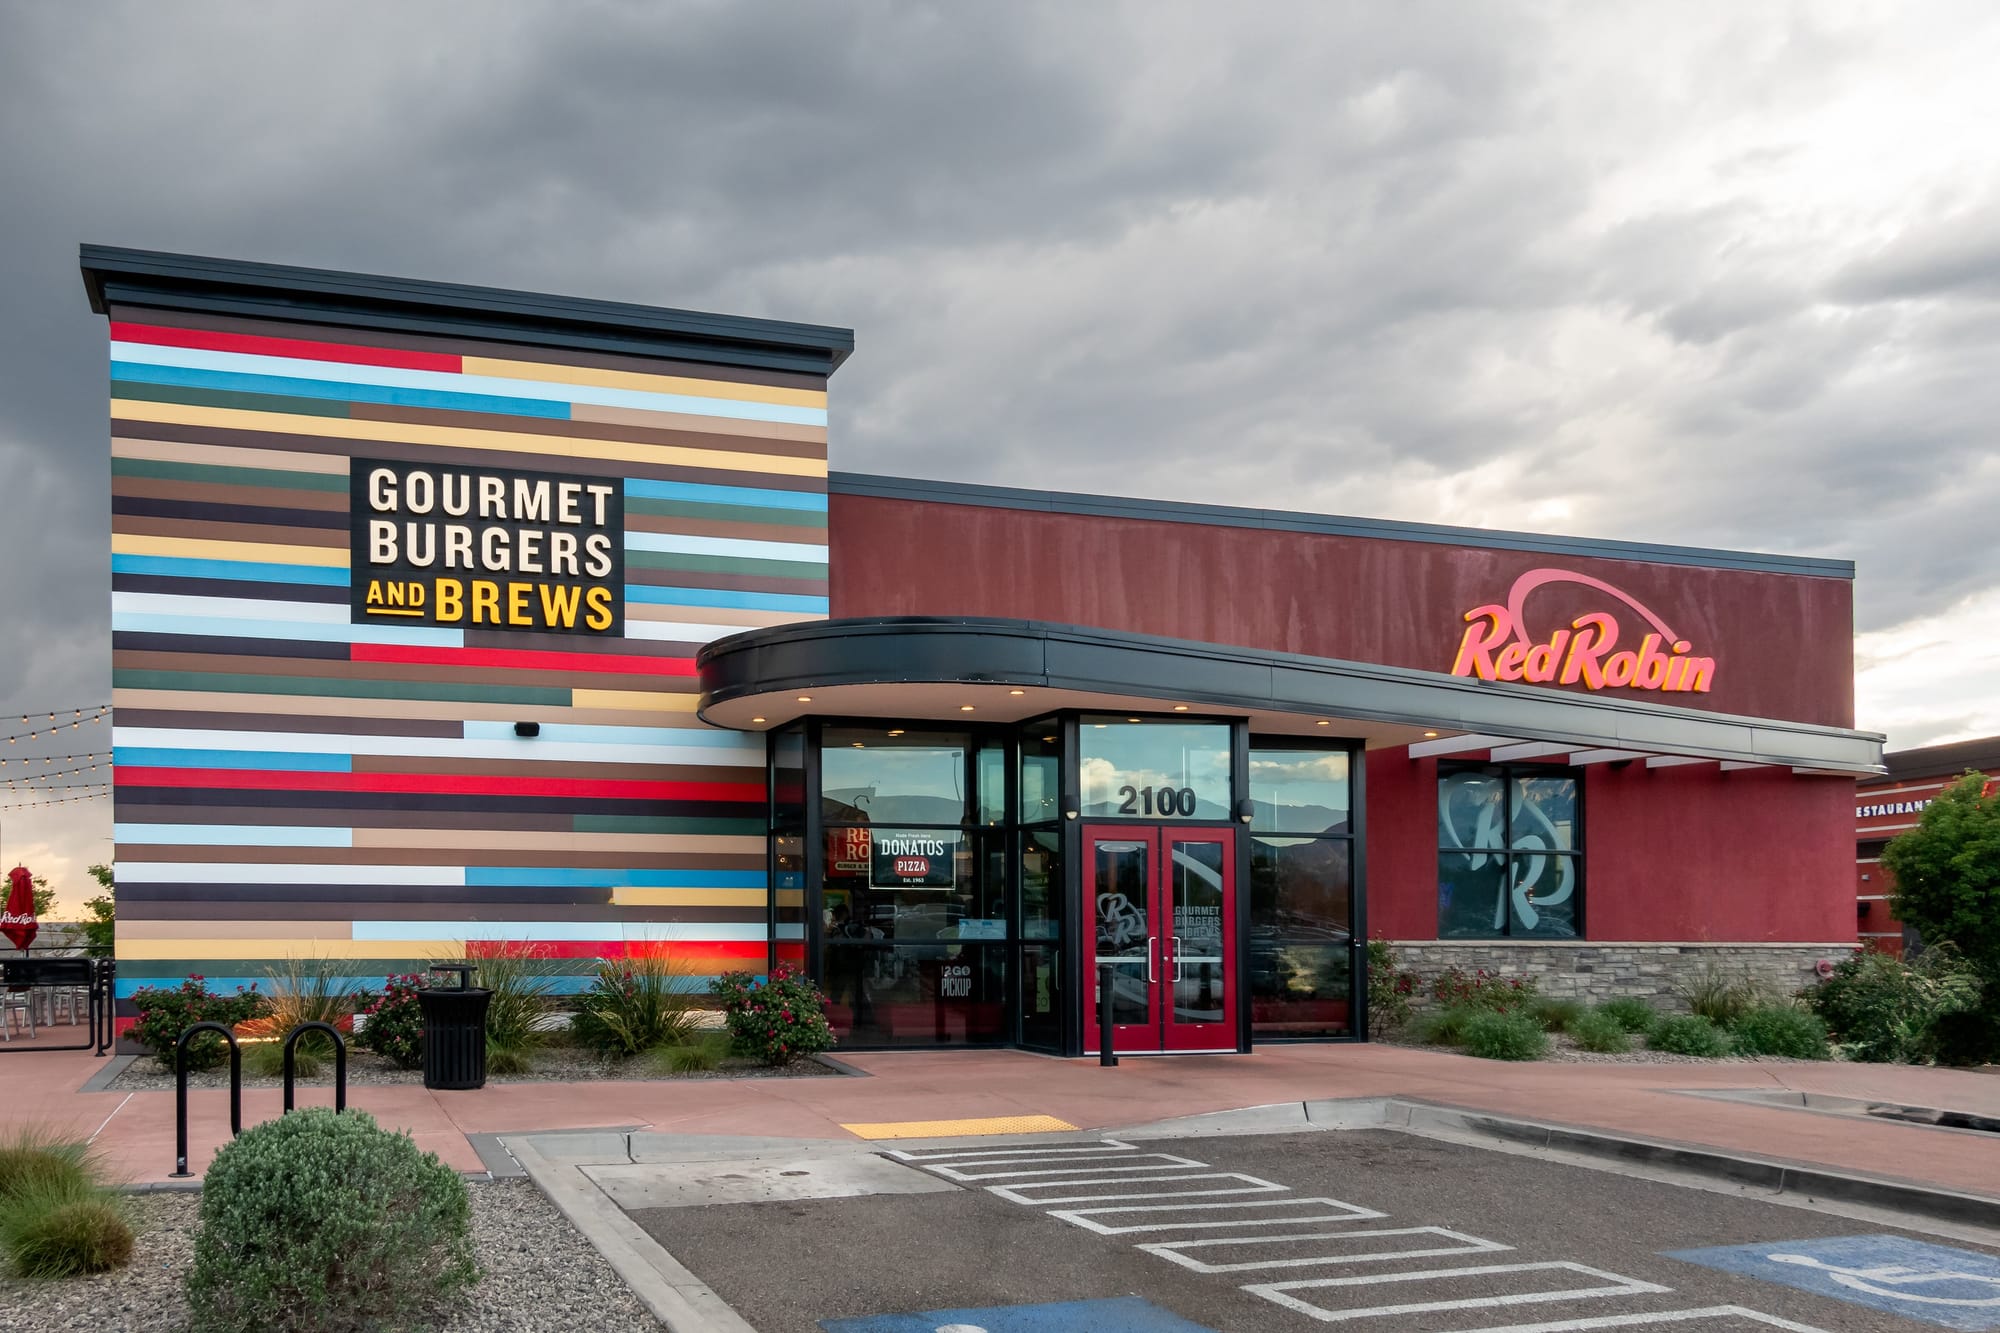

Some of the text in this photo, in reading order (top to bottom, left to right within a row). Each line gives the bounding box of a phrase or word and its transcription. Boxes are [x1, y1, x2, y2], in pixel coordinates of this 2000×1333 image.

[368, 468, 614, 526] GOURMET
[369, 519, 613, 578] BURGERS
[366, 577, 614, 632] AND BREWS
[1451, 604, 1716, 693] Red Robin
[1118, 785, 1197, 817] 2100
[1856, 799, 1932, 818] ESTAURAN
[846, 828, 869, 843] RE
[846, 843, 869, 860] RO
[881, 839, 944, 856] DONATOS
[898, 860, 926, 872] PIZZA
[1175, 906, 1220, 915] GOURMET
[944, 965, 971, 976] 2GO
[941, 977, 972, 997] PICKUP
